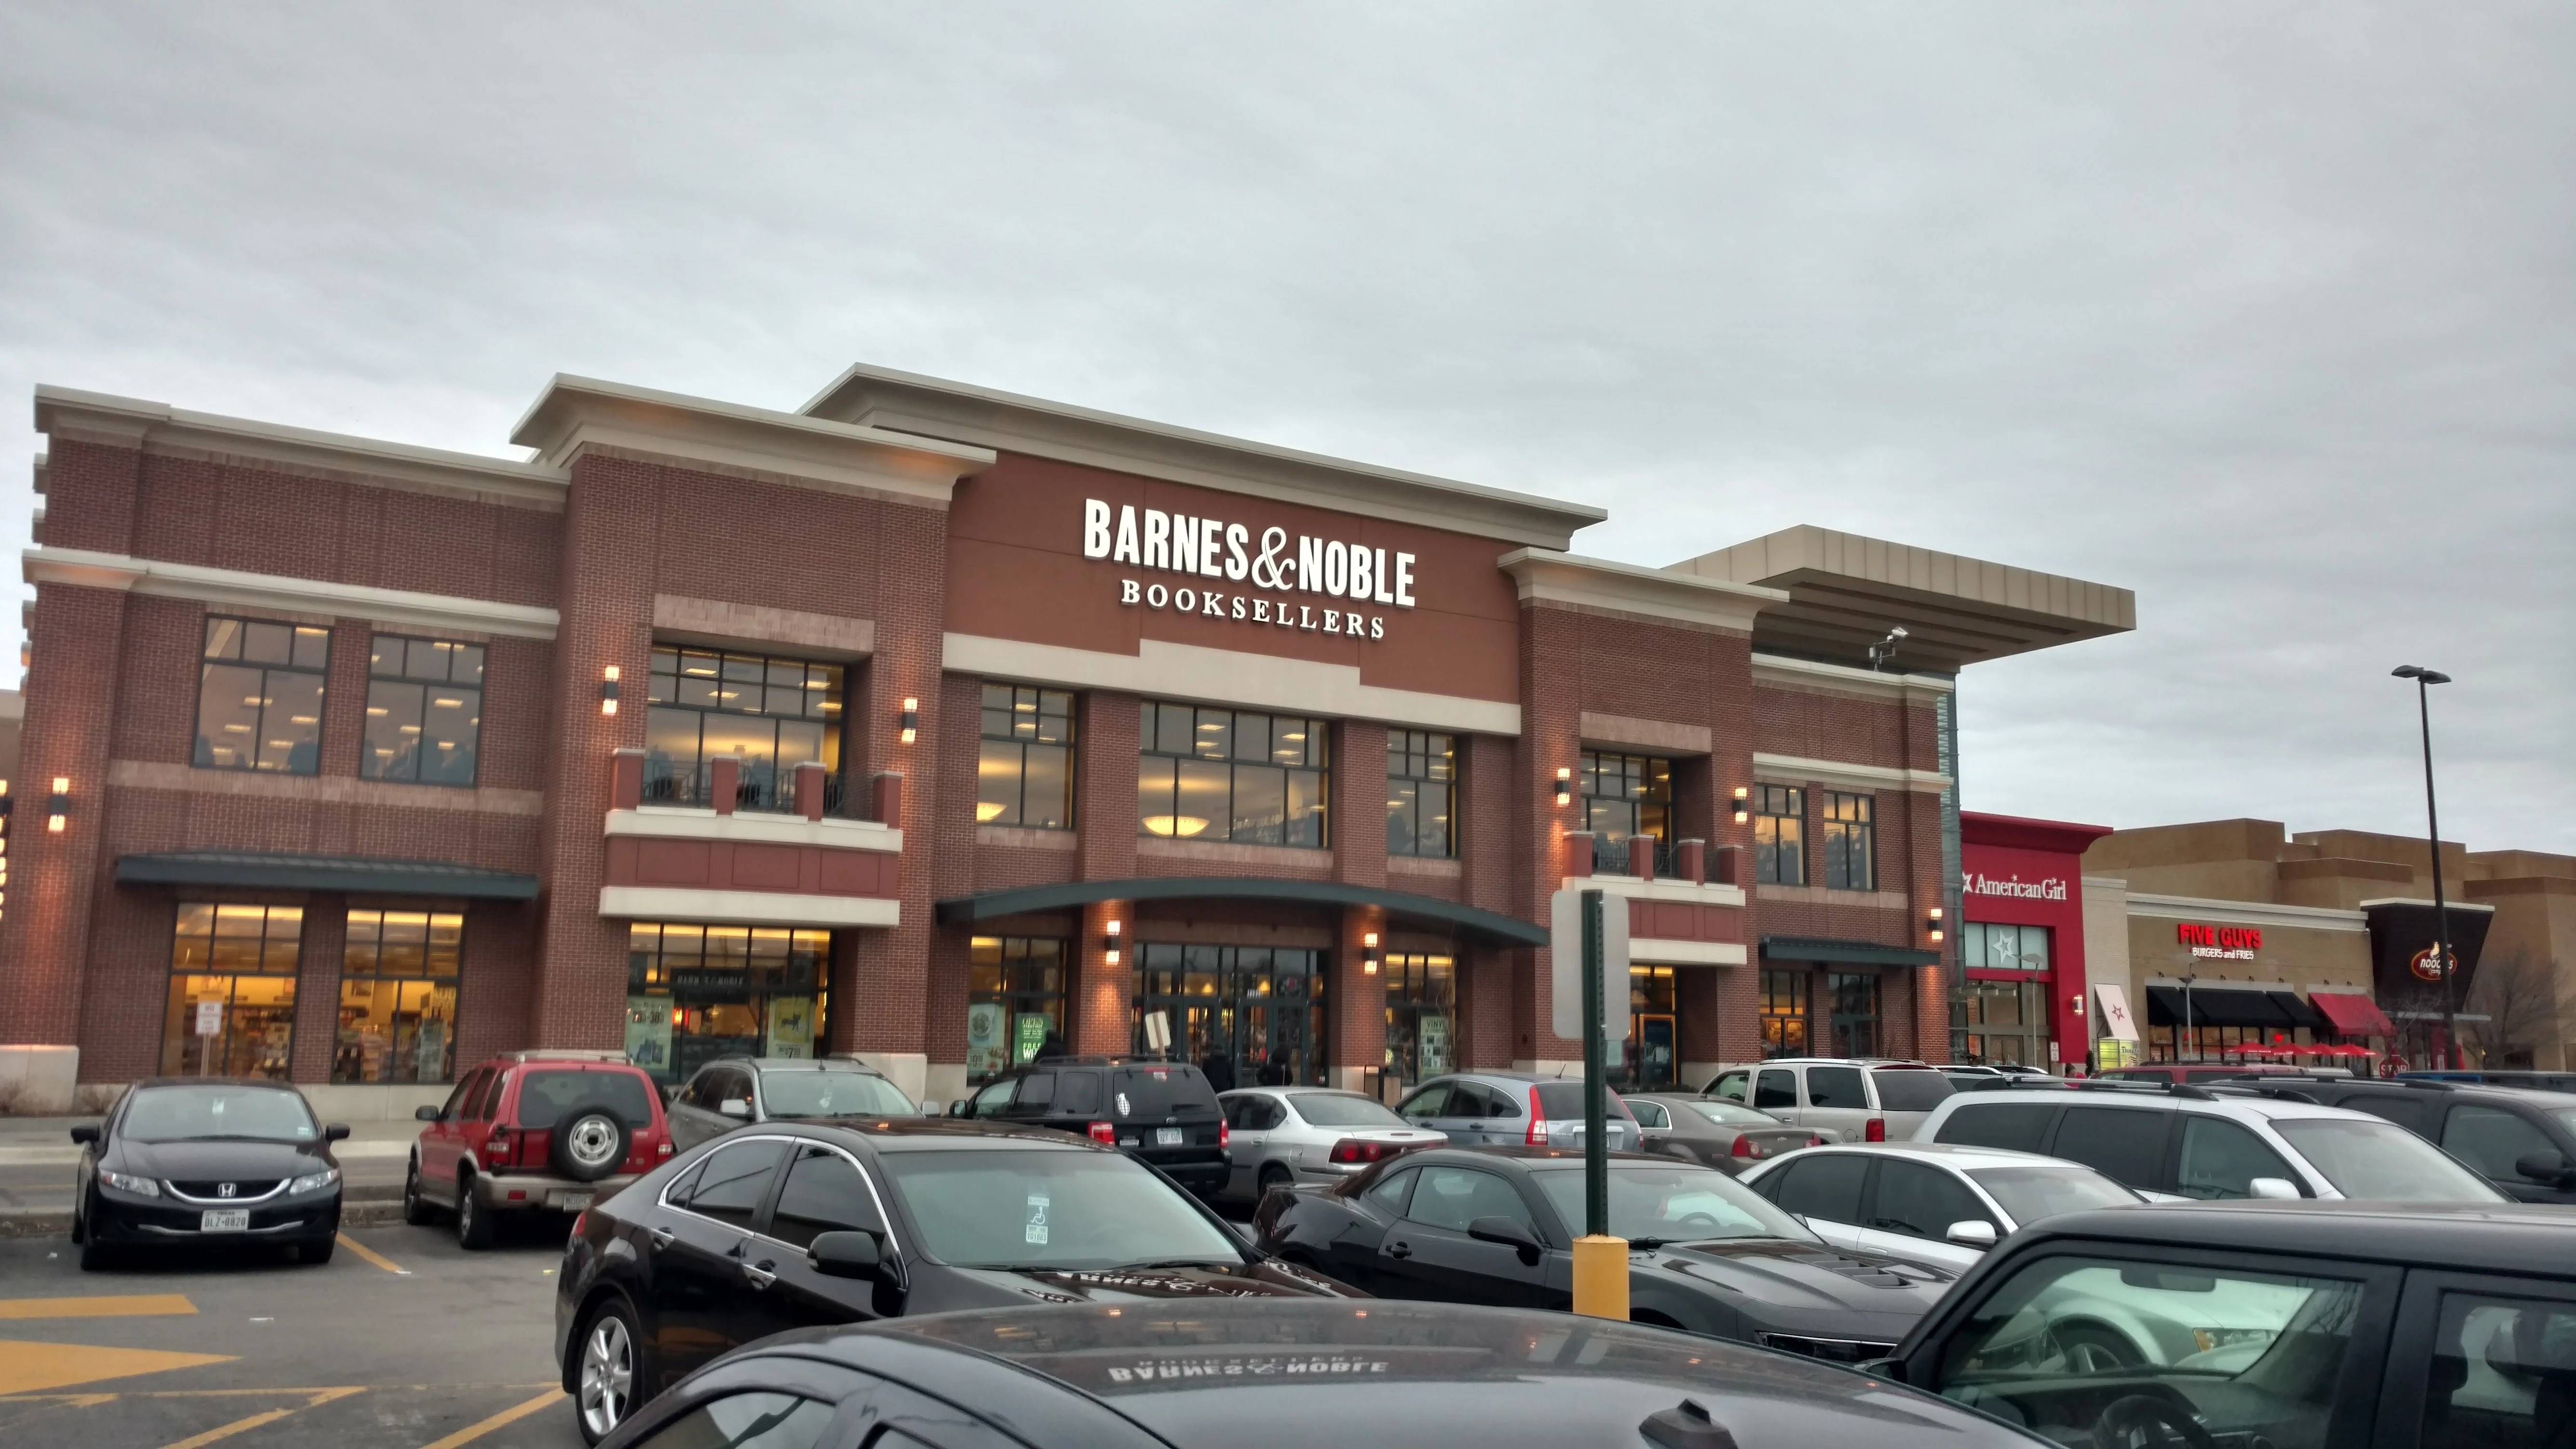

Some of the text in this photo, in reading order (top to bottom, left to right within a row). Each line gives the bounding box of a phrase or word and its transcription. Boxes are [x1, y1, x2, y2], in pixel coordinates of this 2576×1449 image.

[1121, 579, 1384, 639] BOOKSELLERS
[2178, 924, 2263, 949] FIVE GUYS
[2193, 947, 2223, 958] BURGERS
[2236, 950, 2254, 960] FRIES
[2381, 1064, 2407, 1075] STOP
[1028, 1233, 1046, 1241] 101883
